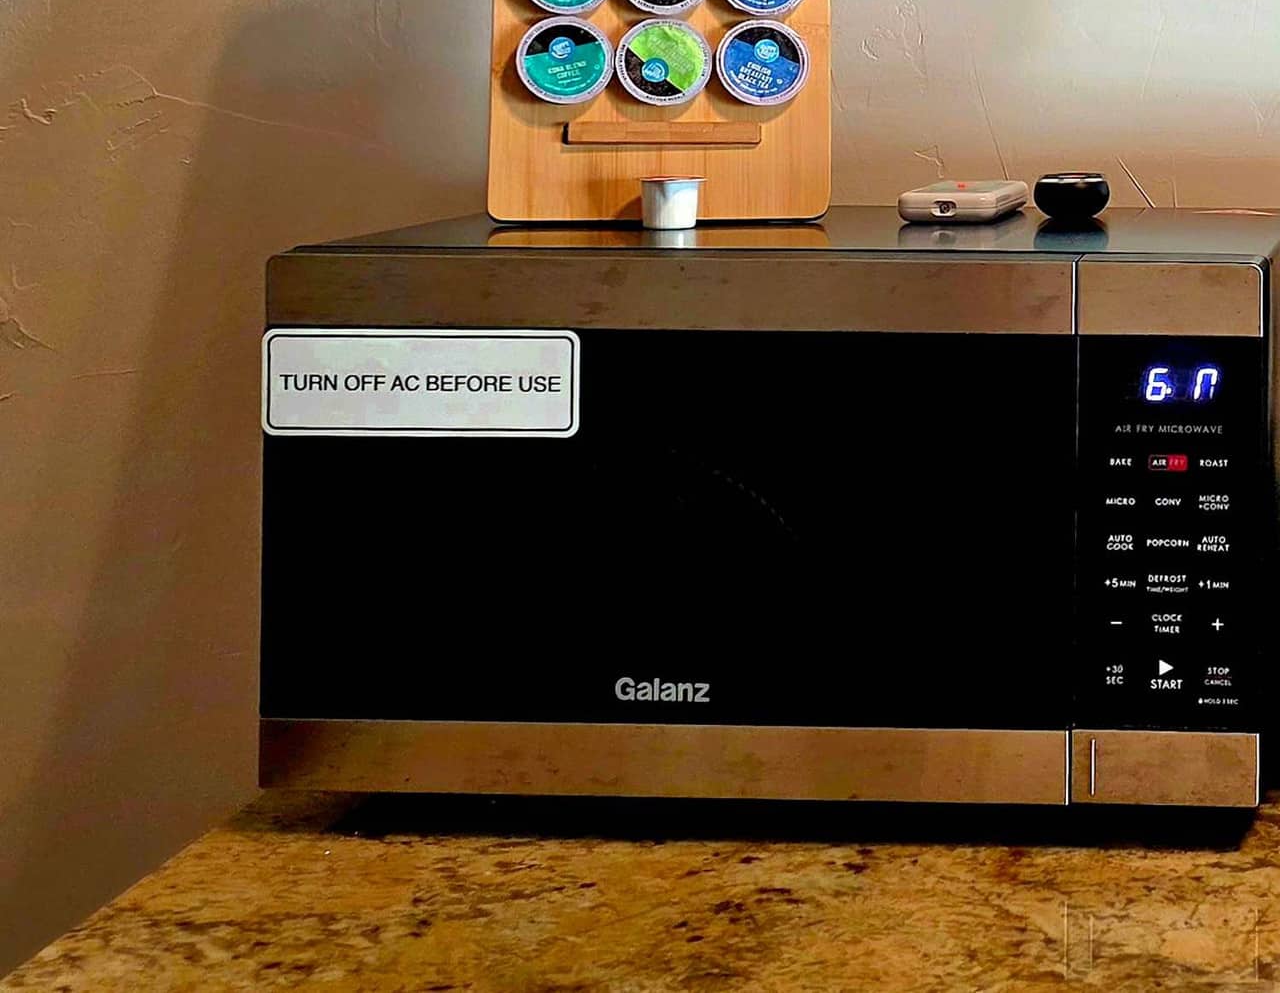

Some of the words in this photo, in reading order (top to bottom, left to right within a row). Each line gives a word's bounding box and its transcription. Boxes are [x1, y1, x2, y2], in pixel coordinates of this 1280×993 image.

[279, 373, 339, 392] TURN
[343, 374, 387, 393] OFF
[390, 374, 421, 393] AC
[425, 374, 513, 394] BEFORE
[518, 375, 562, 394] USE
[1115, 424, 1132, 434] AIR
[1136, 424, 1154, 434] FRY
[1158, 425, 1224, 435] MICROWAVE
[1109, 458, 1133, 467] BAKE
[1152, 459, 1167, 467] AIR
[1199, 459, 1229, 467] ROAST
[1105, 497, 1136, 506] MICRO
[1154, 498, 1182, 507] CONV
[1199, 495, 1230, 503] MICRO
[1107, 534, 1133, 542] AUTO
[1201, 536, 1226, 544] AUTO
[1106, 543, 1134, 551] COOK
[1146, 539, 1190, 547] POPCORN
[1197, 544, 1231, 552] REHEAT
[1147, 574, 1187, 583] DEFROST
[1119, 580, 1137, 588] MIN
[1212, 581, 1230, 589] MIN
[1151, 613, 1183, 622] CLOCK
[1153, 624, 1181, 634] TIMER
[1207, 666, 1230, 676] STOP
[1105, 676, 1124, 685] SEC
[1150, 678, 1184, 690] START
[1203, 679, 1232, 687] CANCEL
[613, 676, 712, 705] Galanz
